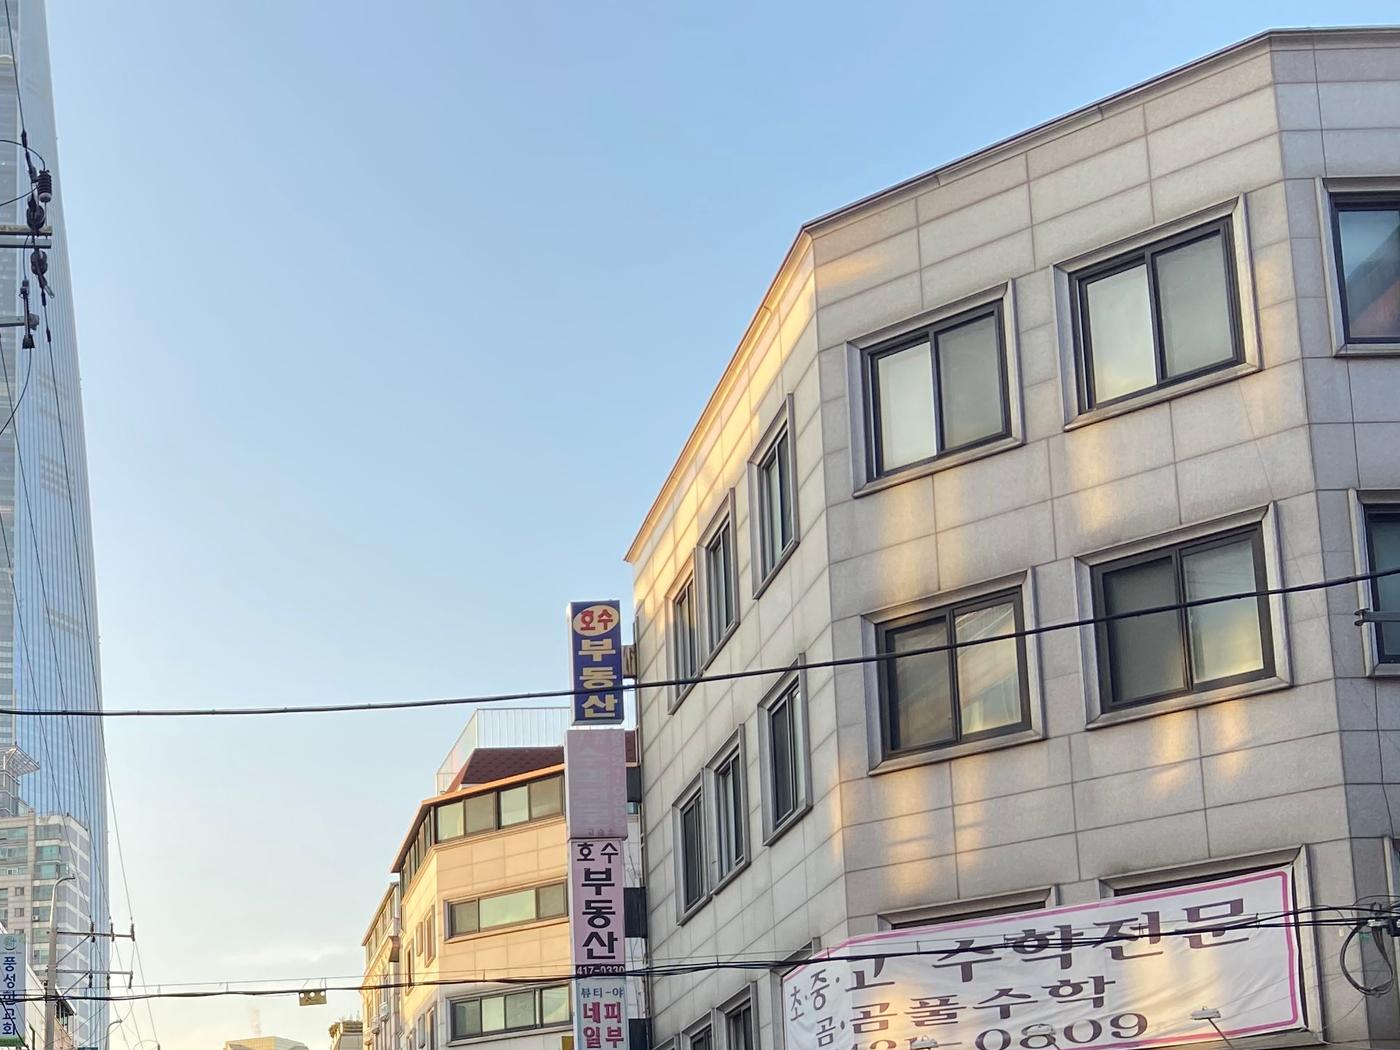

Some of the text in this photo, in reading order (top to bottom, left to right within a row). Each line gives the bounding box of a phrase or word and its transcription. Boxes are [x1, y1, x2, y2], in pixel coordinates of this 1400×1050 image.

[579, 609, 615, 632] 호수
[577, 637, 618, 719] 부동산
[576, 841, 620, 863] 호수
[581, 867, 619, 961] 부동산
[931, 897, 1251, 984] 수학전문
[2, 956, 17, 1036] 풍성한교회
